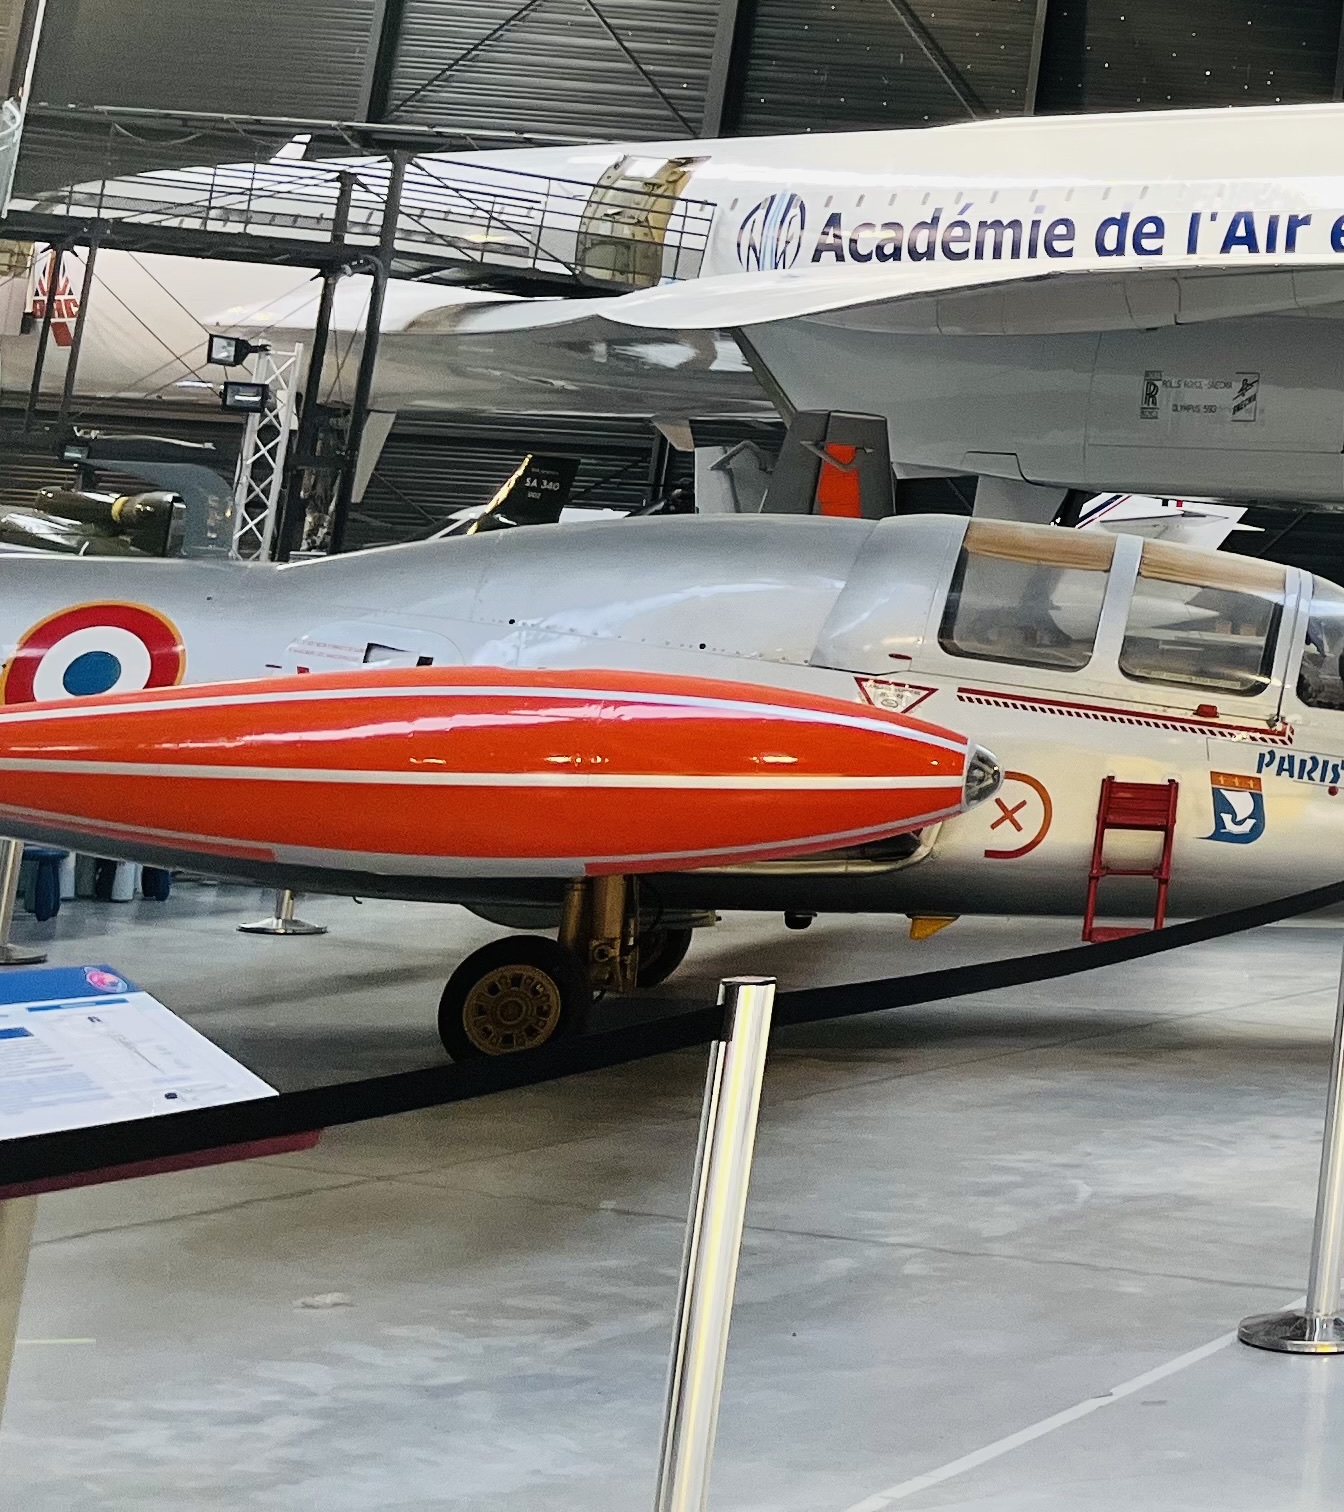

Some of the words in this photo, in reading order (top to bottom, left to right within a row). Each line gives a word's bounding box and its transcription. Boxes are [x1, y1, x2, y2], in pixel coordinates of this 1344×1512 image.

[811, 202, 1075, 264] Académie
[1096, 204, 1165, 257] de
[1186, 209, 1312, 255] l'Air
